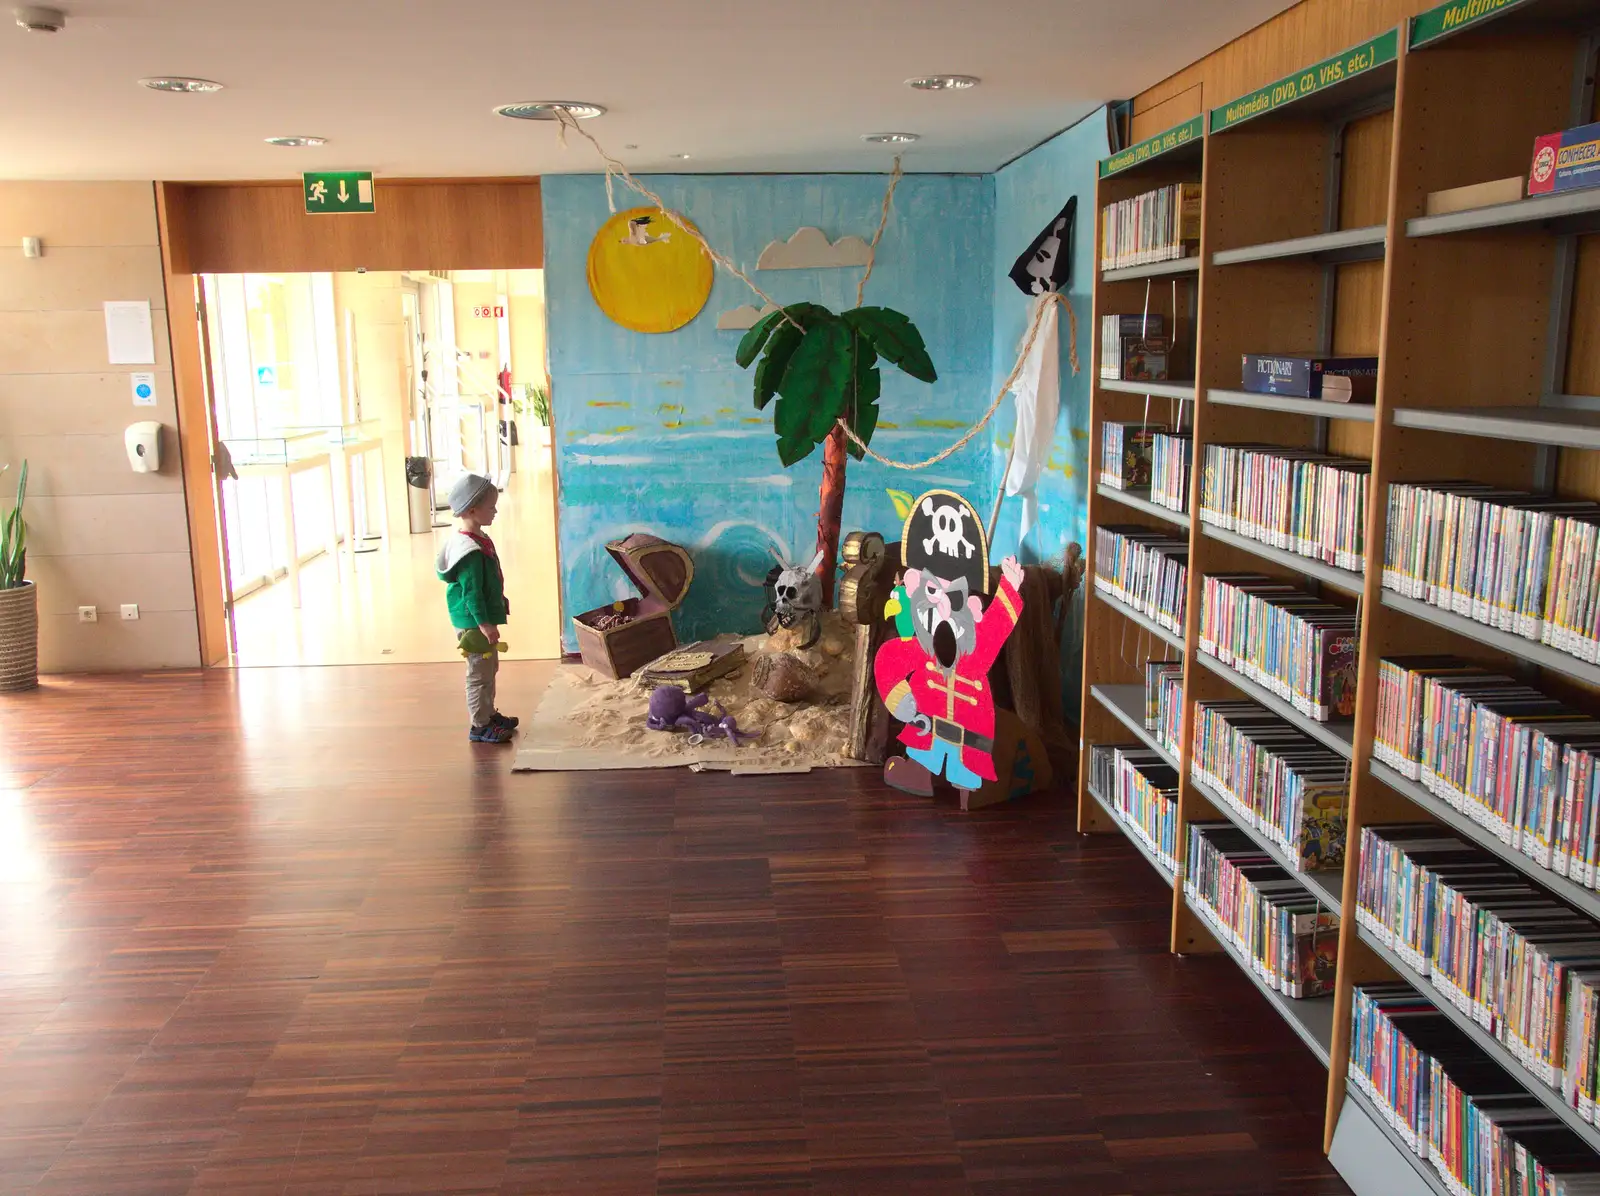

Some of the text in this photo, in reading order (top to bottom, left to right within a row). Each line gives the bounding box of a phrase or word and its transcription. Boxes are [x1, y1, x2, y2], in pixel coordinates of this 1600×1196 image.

[1225, 46, 1375, 124] Multimédia (DVD, CD, VHS, etc.)
[1108, 151, 1135, 173] Multimédia
[1557, 143, 1597, 164] CONHECER
[1257, 358, 1293, 376] PICTIONARY
